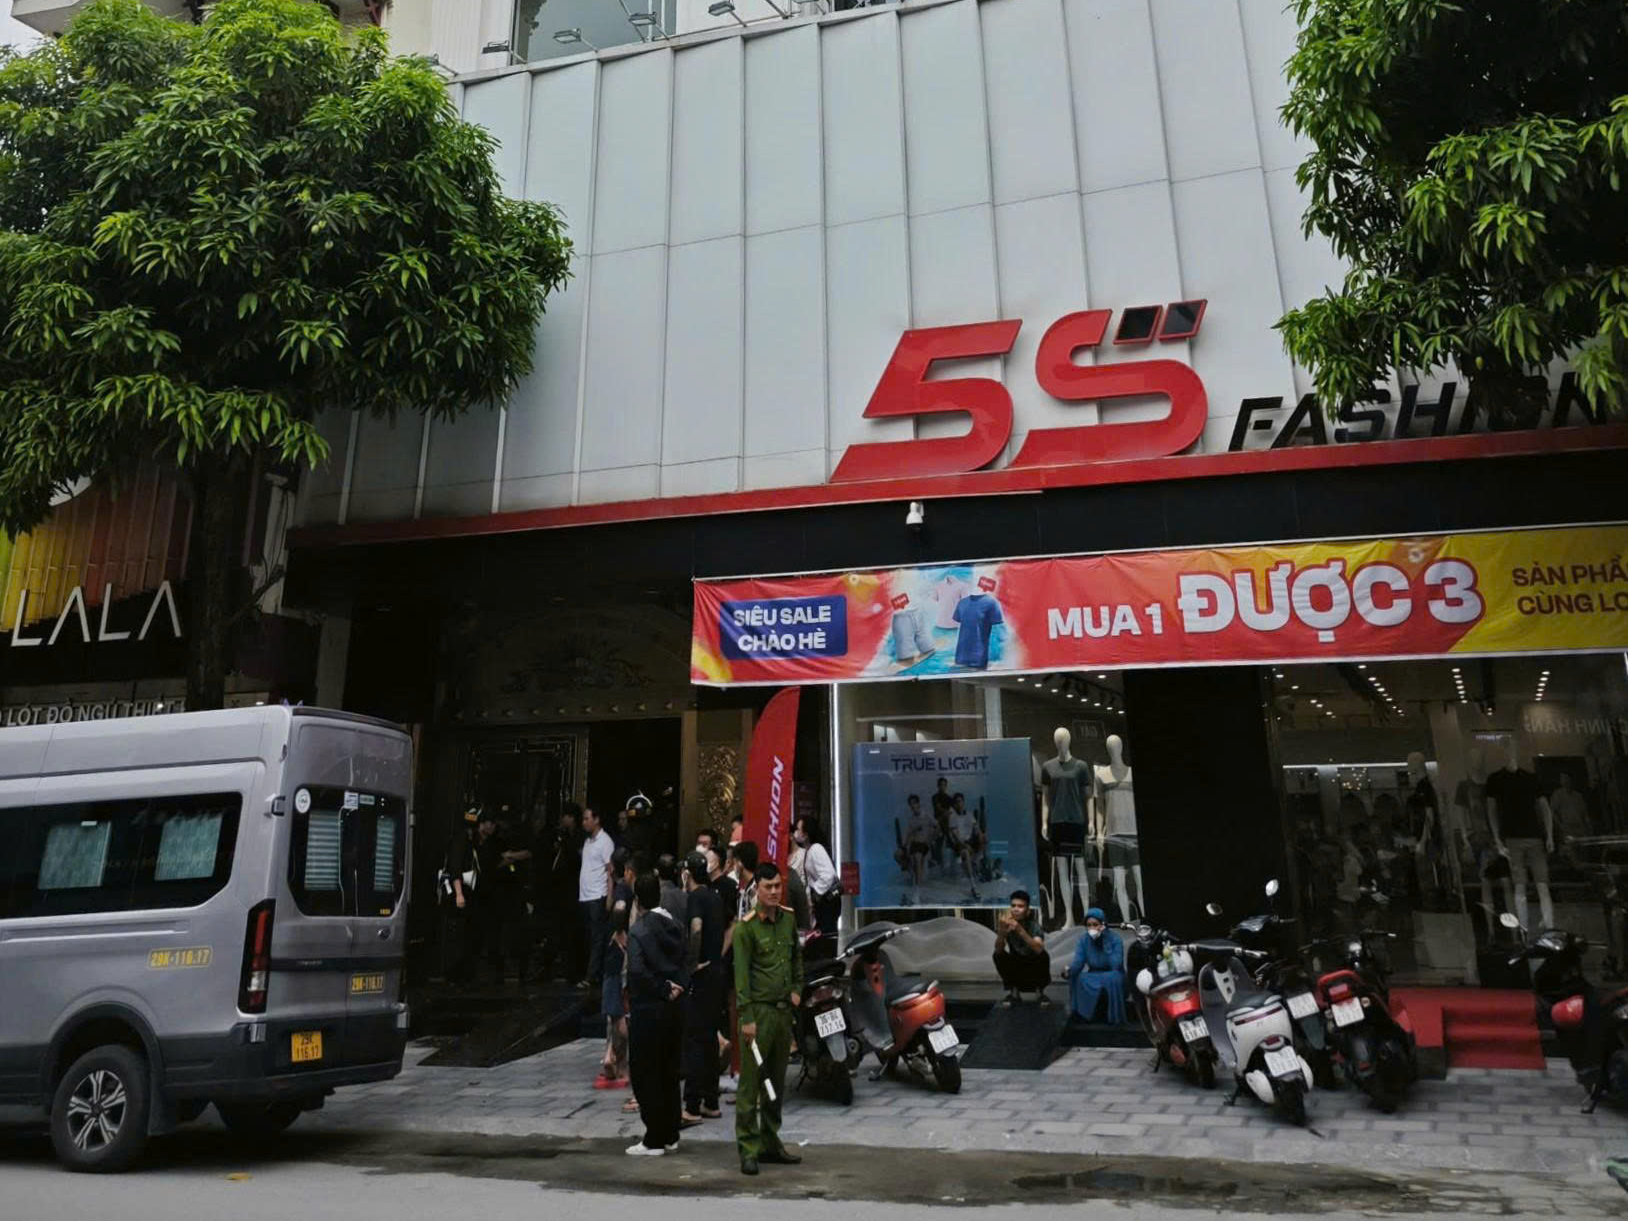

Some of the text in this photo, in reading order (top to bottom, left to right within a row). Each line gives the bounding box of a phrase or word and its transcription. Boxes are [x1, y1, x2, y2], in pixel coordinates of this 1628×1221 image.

[1511, 555, 1628, 587] SẢN PHẨ
[11, 580, 182, 647] LALA
[733, 605, 832, 627] SIÊU SALE
[1047, 560, 1483, 643] MUA 1 ĐƯỢC 3
[1517, 590, 1595, 616] CÙNG
[738, 628, 827, 652] CHÀO HÈ
[890, 755, 990, 773] TRUE LIGHT
[767, 755, 785, 865] SHION
